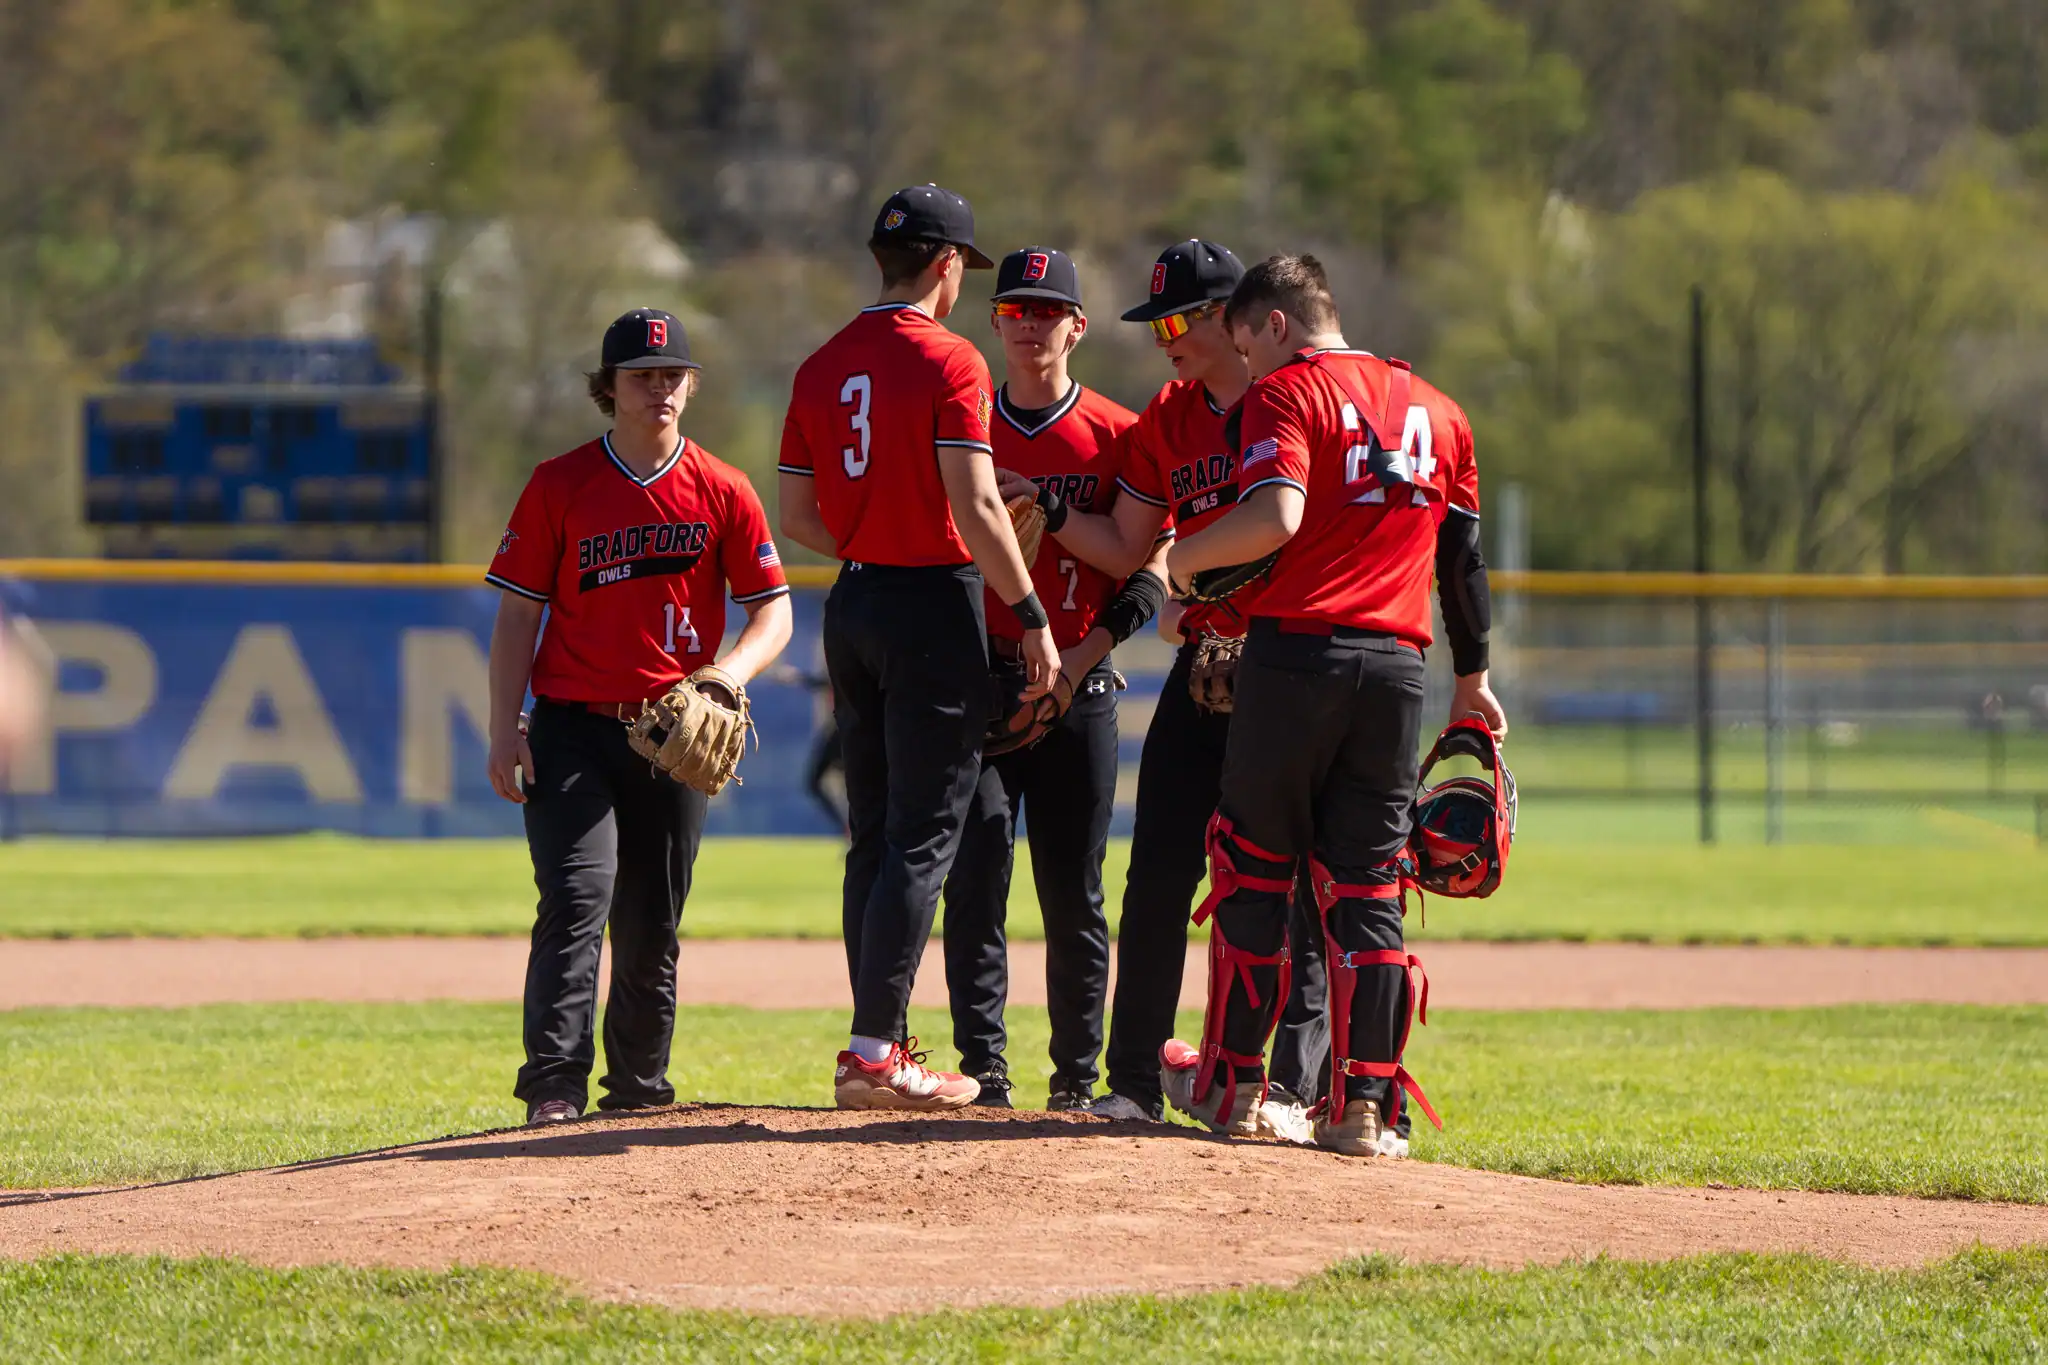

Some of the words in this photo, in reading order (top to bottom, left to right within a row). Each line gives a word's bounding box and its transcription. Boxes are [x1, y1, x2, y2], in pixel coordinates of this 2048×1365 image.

[1022, 253, 1049, 281] B
[1151, 262, 1168, 295] B
[646, 319, 668, 348] B
[839, 371, 873, 480] 3
[1191, 491, 1219, 514] OWLS
[577, 521, 710, 572] BRADFORD
[597, 563, 632, 585] OWLS
[1058, 558, 1079, 611] 7
[662, 602, 702, 654] 14
